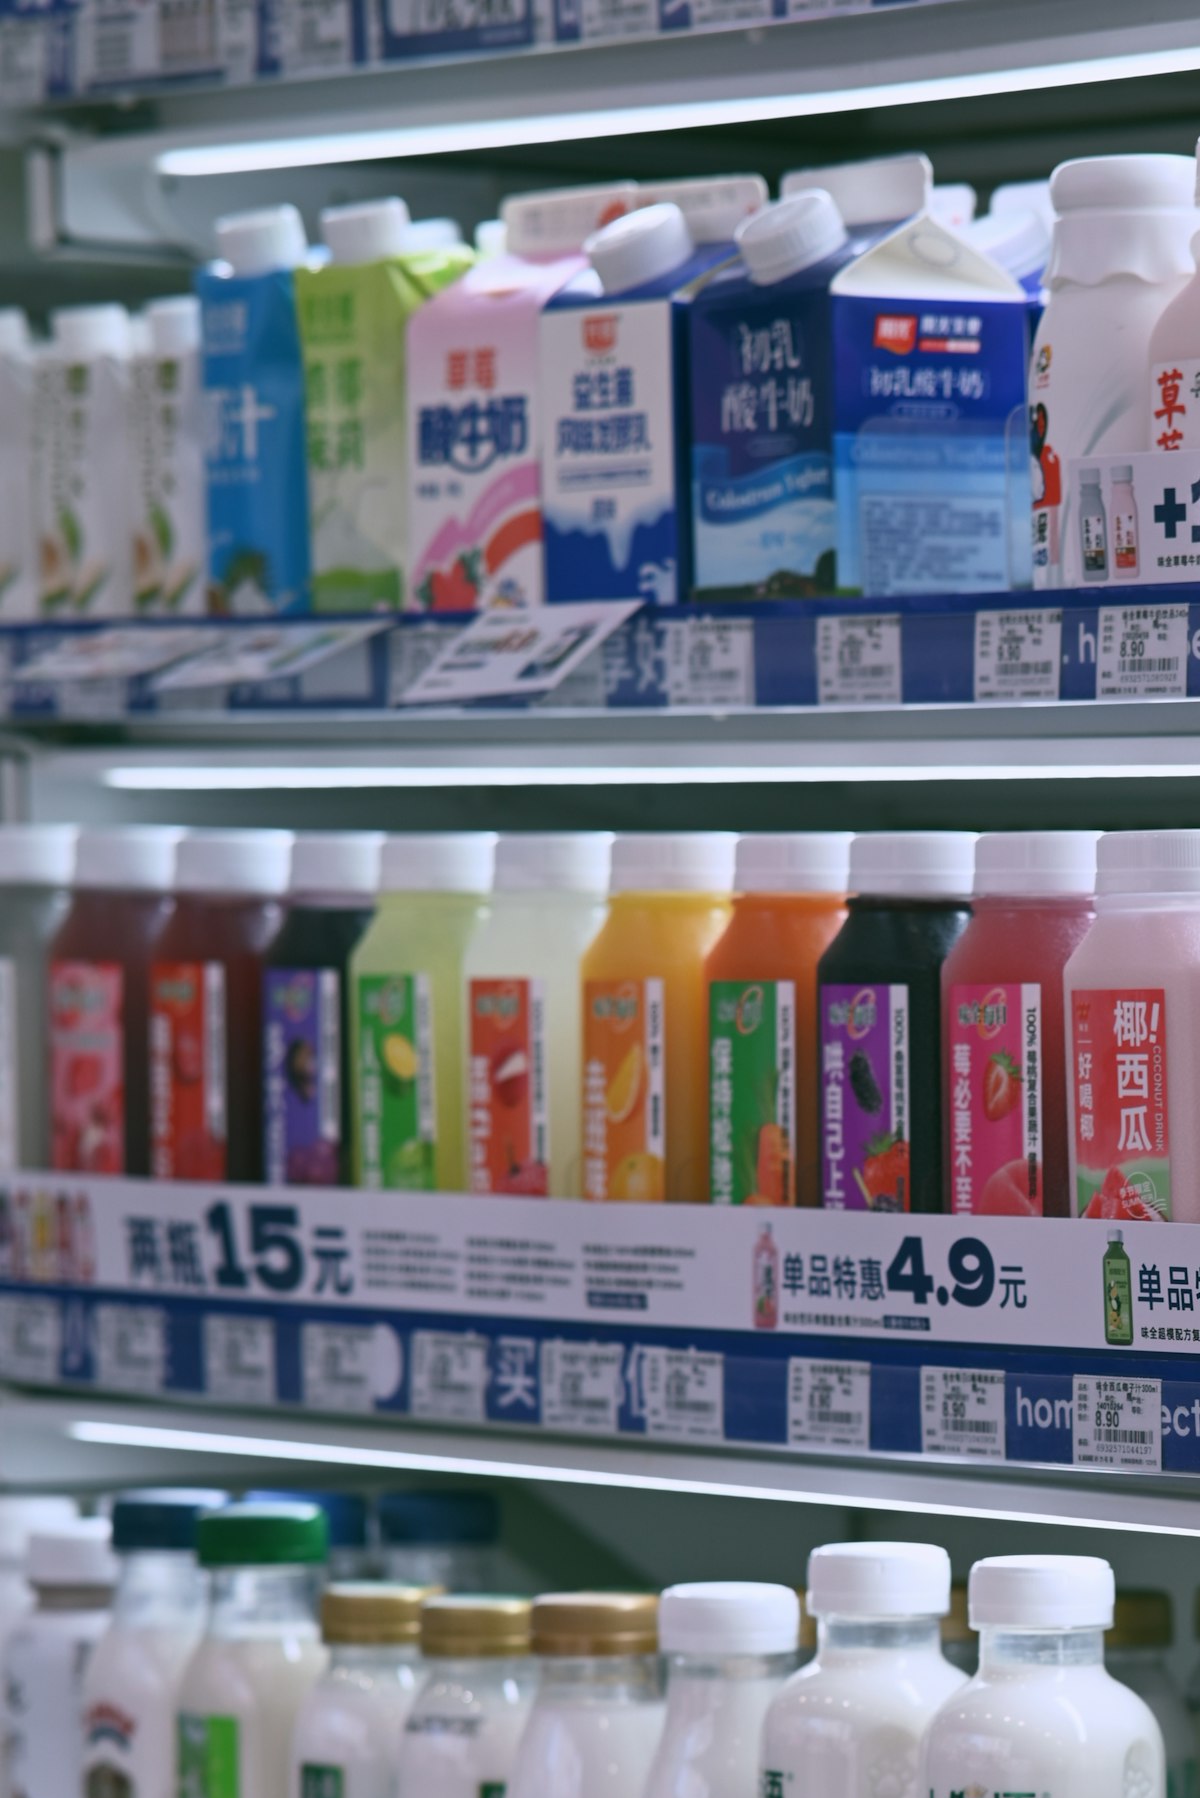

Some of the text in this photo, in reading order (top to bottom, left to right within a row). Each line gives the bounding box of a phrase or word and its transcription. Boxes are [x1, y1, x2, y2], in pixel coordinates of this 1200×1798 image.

[721, 379, 815, 433] 酸牛奶
[1120, 641, 1145, 658] 8.90
[1152, 1045, 1164, 1152] COCONUT DRINK
[782, 1236, 1027, 1309] 单品特惠4.9元
[1095, 1411, 1120, 1428] 8.90
